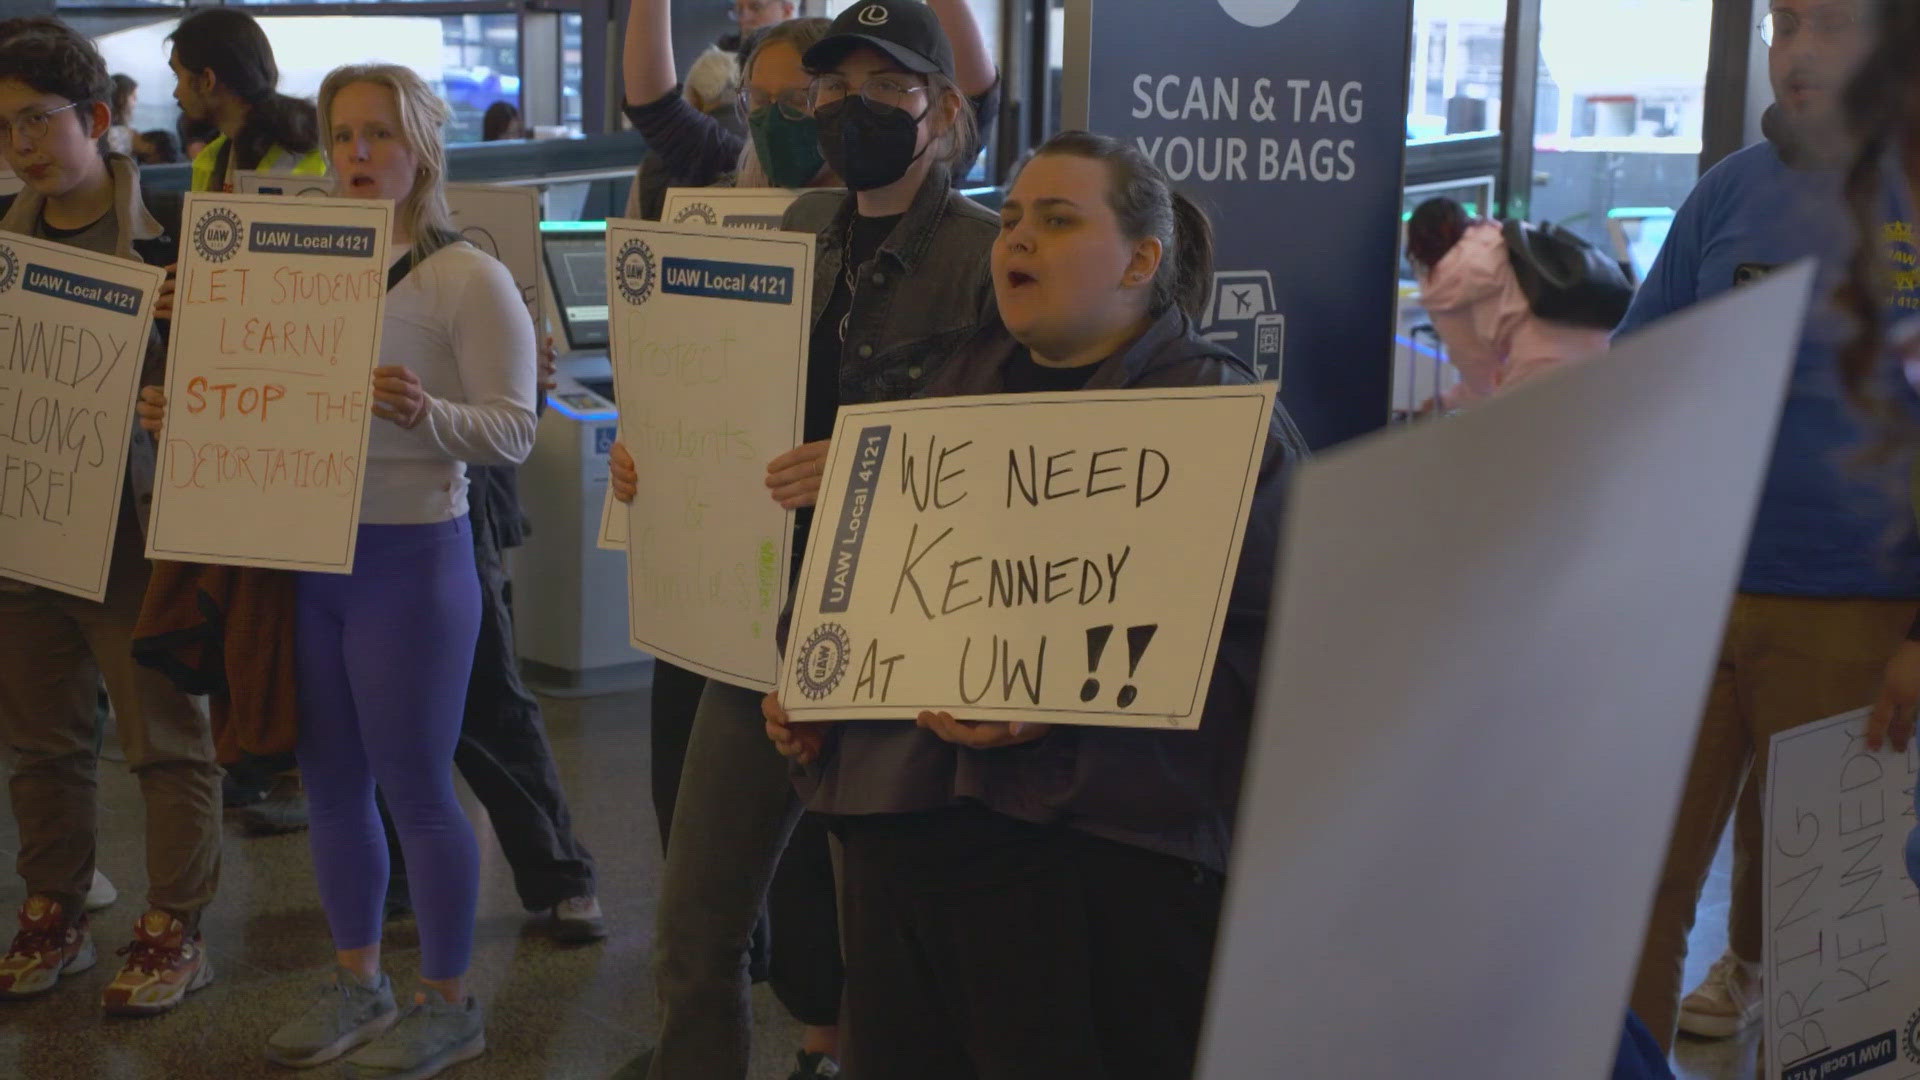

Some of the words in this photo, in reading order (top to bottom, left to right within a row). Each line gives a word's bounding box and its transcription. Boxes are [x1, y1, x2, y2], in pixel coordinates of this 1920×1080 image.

[1131, 73, 1239, 121] SCAN
[1249, 77, 1277, 122] &
[1286, 78, 1363, 124] TAG
[1136, 135, 1248, 182] YOUR
[1258, 137, 1356, 182] BAGS
[206, 228, 230, 242] UAW
[255, 230, 291, 247] UAW
[294, 232, 332, 249] Local
[336, 234, 369, 251] 4121
[29, 270, 64, 292] UAW
[65, 279, 102, 302] Local
[104, 290, 136, 310] 4121
[186, 267, 250, 306] LET
[271, 265, 385, 306] STUDENTS
[666, 267, 700, 289] UAW
[704, 270, 746, 292] Local
[749, 275, 786, 296] 4121
[220, 316, 346, 366] LEARN!
[186, 375, 288, 423] STOP
[306, 390, 364, 424] THE
[168, 438, 356, 498] DEPORTATIONS
[901, 432, 973, 513] WE
[1006, 445, 1170, 508] NEED
[830, 551, 854, 604] UAW
[843, 488, 868, 544] Local
[857, 434, 882, 482] 4121
[889, 522, 1131, 620] KENNEDY
[813, 645, 832, 680] UAW
[852, 637, 905, 703] AT
[959, 633, 1047, 706] UW
[1079, 623, 1158, 709] !!
[1835, 729, 1890, 1003] KENNEDY
[1774, 805, 1832, 1068] BRING
[1787, 1066, 1818, 1080] 412
[1820, 1052, 1857, 1078] Local
[1858, 1038, 1892, 1064] UAW
